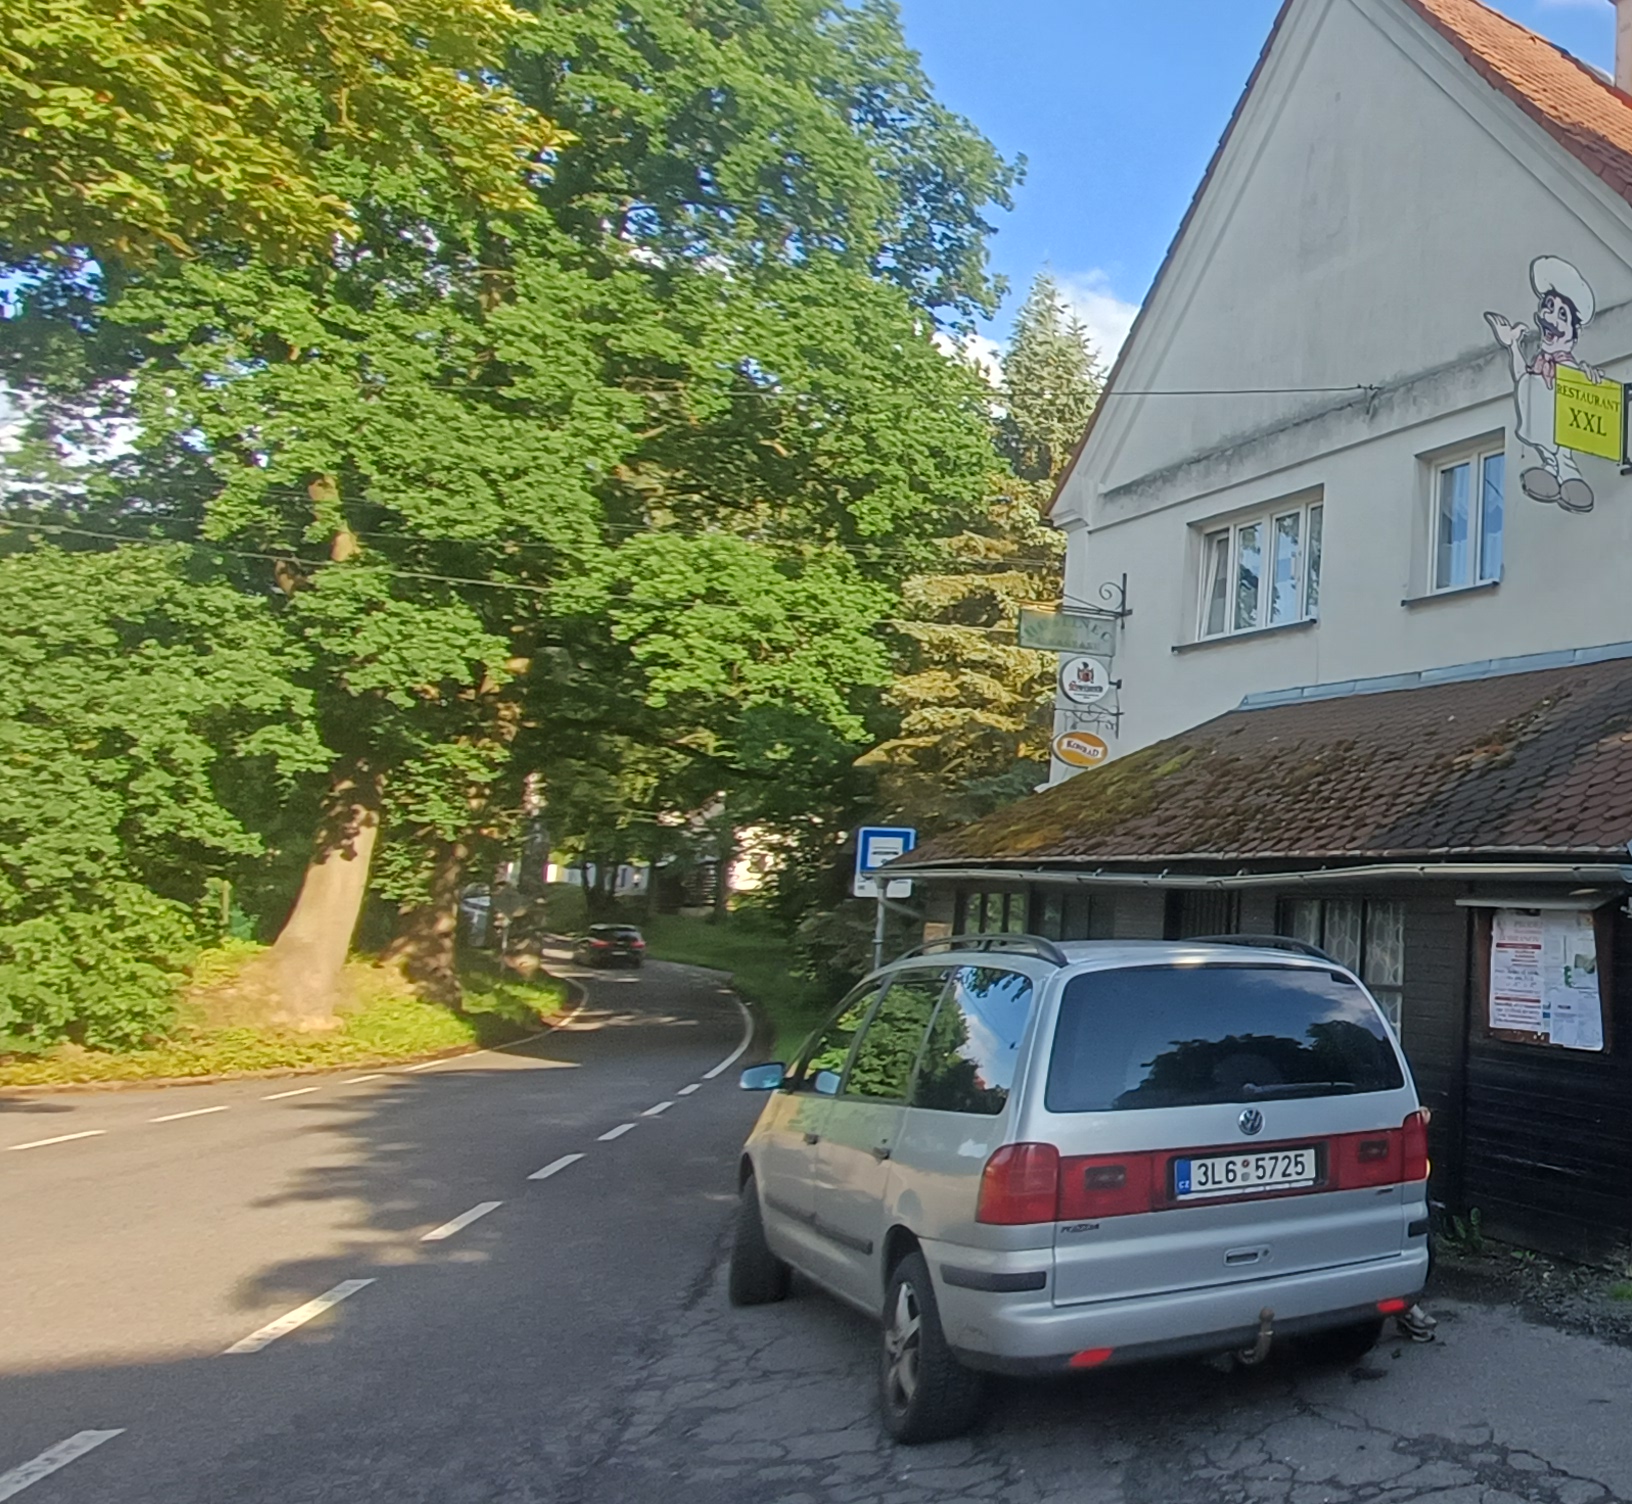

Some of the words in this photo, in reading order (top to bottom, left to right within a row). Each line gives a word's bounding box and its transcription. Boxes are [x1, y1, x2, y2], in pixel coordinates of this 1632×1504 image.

[1556, 384, 1621, 412] RESTAURANT
[1568, 407, 1607, 436] XXL
[1178, 1181, 1190, 1189] CZ
[1197, 1160, 1238, 1186] 3L6
[1255, 1153, 1306, 1180] 5725
